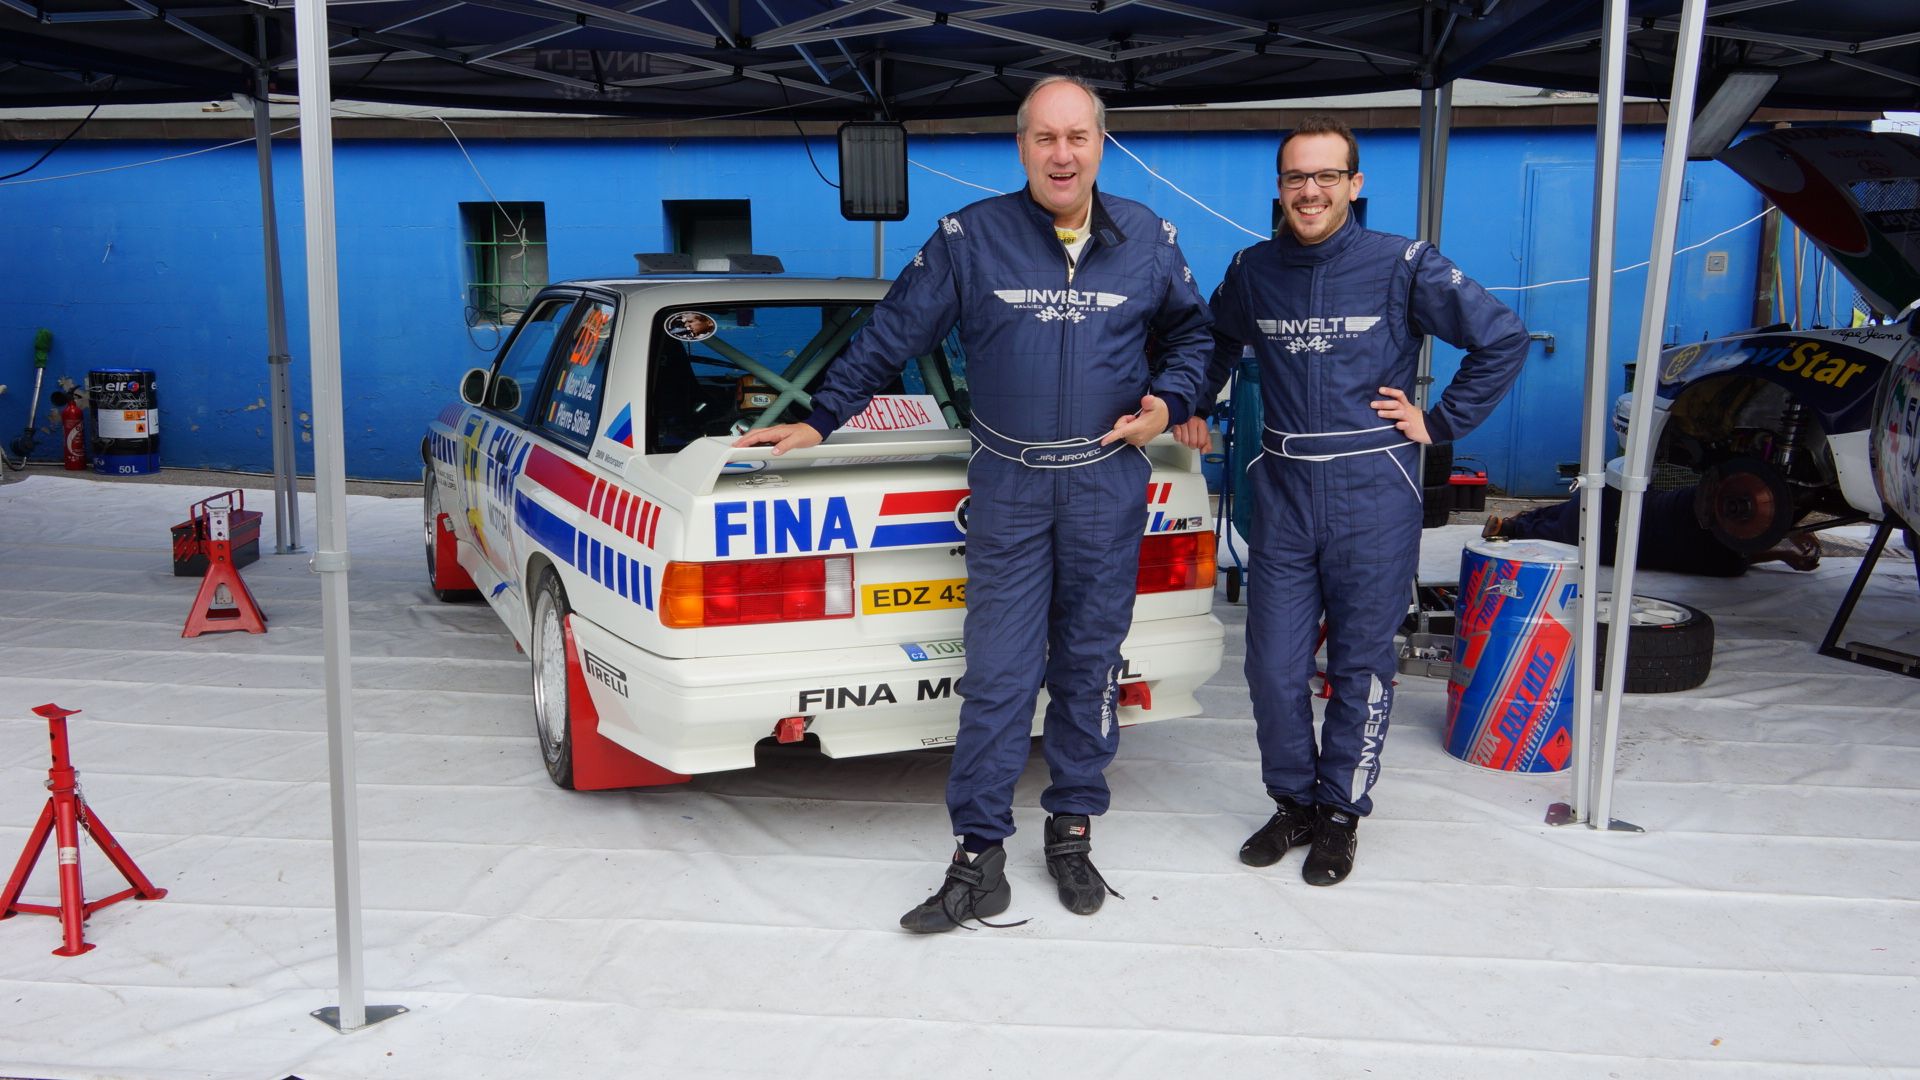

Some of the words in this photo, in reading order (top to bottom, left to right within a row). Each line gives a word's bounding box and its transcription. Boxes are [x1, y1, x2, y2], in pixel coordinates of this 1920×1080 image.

[1026, 289, 1097, 306] INVELT
[1277, 317, 1344, 334] INVELT
[1858, 328, 1904, 344] Jeans
[105, 381, 128, 392] elf
[846, 397, 932, 431] URETANA
[1057, 447, 1101, 462] JIROVEC
[119, 465, 132, 474] 50
[714, 496, 858, 557] FINA
[873, 587, 931, 608] EDZ
[583, 648, 629, 699] PIRELLI
[799, 683, 897, 713] FINA
[1358, 704, 1383, 770] INVELT
